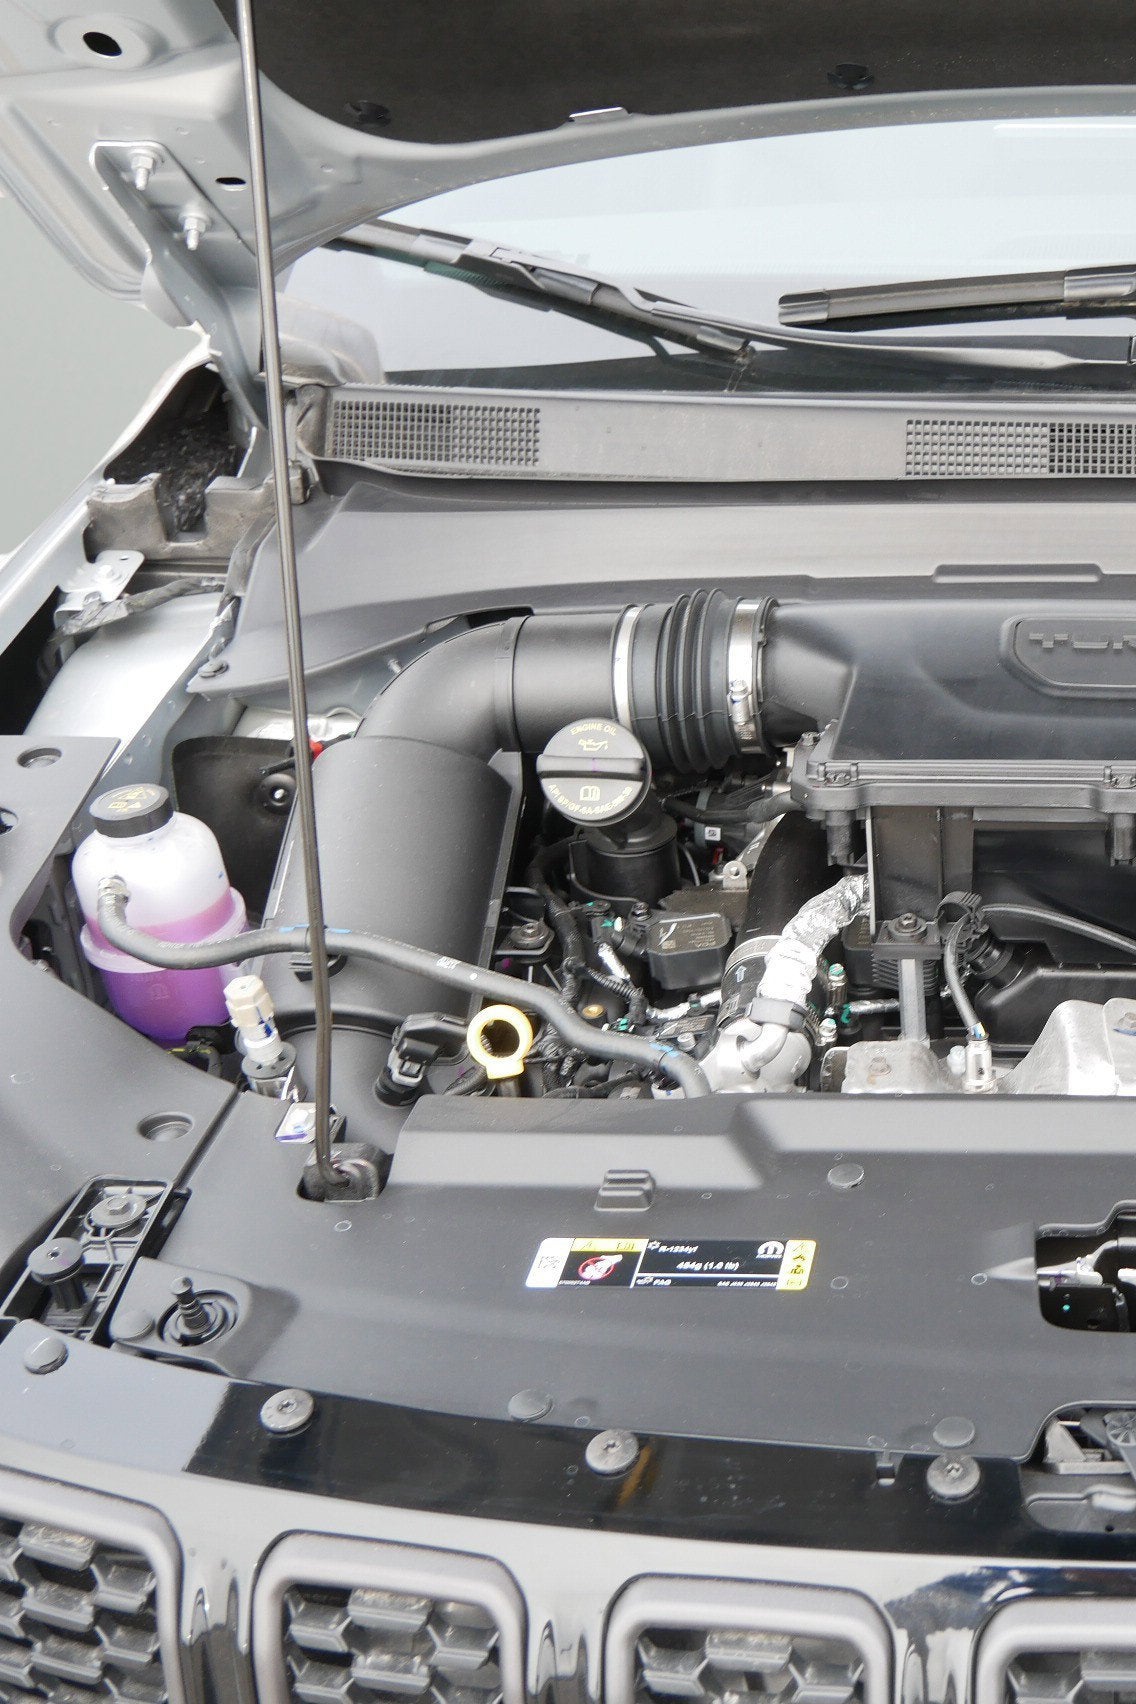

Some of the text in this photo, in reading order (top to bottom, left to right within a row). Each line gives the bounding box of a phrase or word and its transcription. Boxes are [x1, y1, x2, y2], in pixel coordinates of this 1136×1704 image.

[570, 722, 618, 737] ENGINE OIL
[548, 784, 561, 799] API
